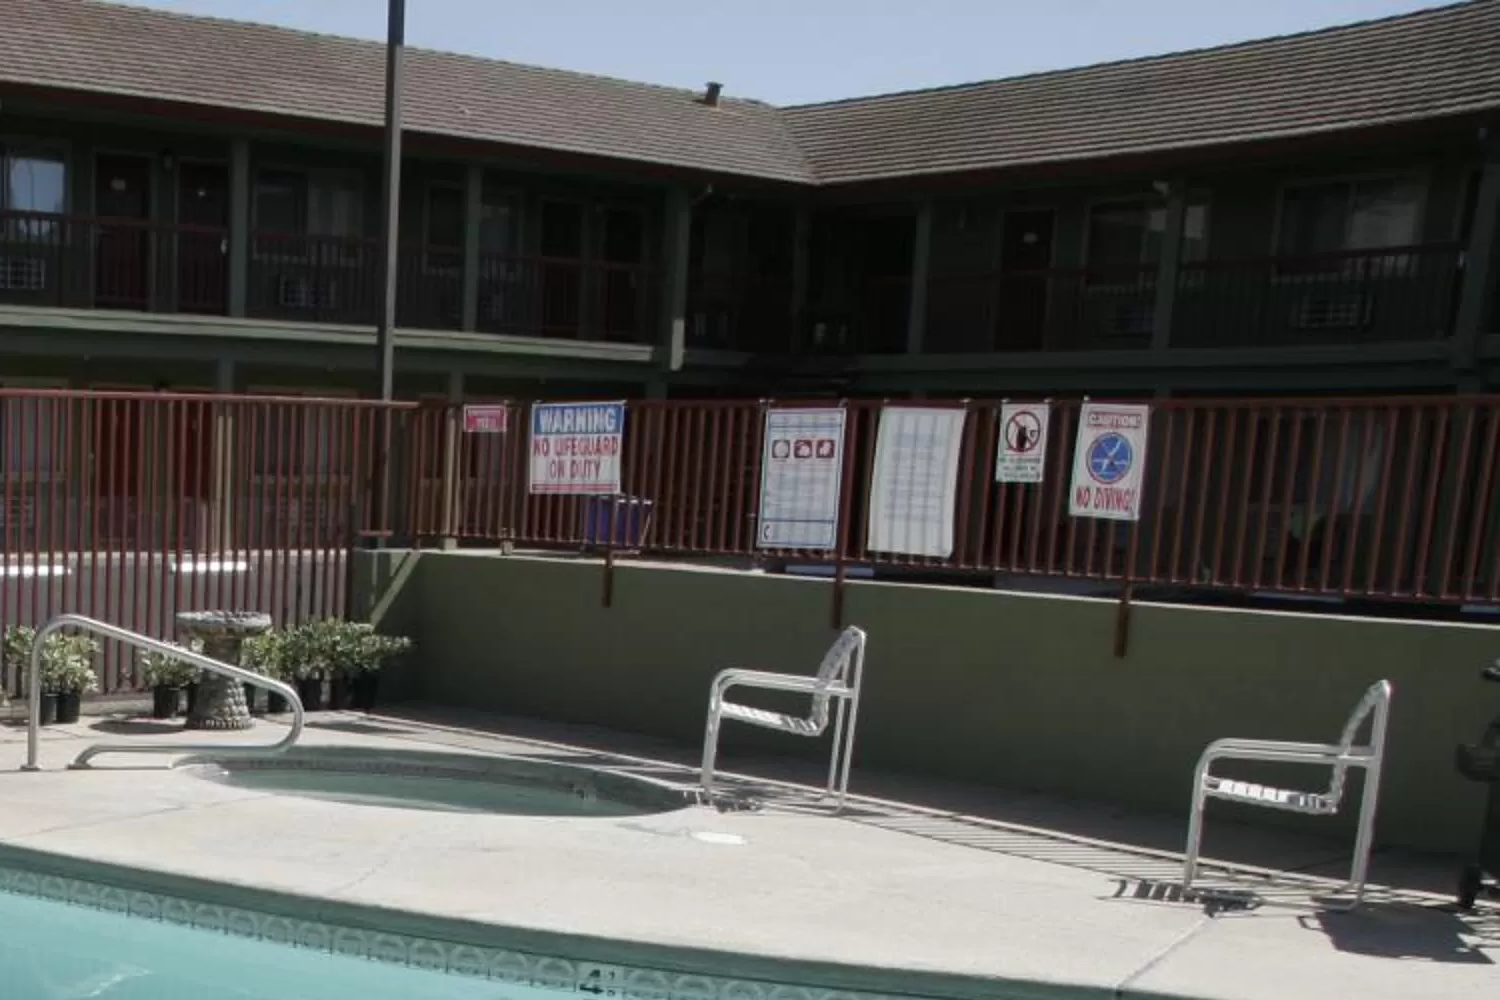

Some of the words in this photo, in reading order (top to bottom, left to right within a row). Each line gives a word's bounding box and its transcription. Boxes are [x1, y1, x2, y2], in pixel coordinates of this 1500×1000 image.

[540, 407, 617, 433] WARNING
[533, 436, 550, 456] NO
[555, 435, 618, 456] LIFEGUARD
[550, 459, 565, 479] ON
[570, 459, 601, 479] DUTY
[1076, 486, 1091, 509] NO
